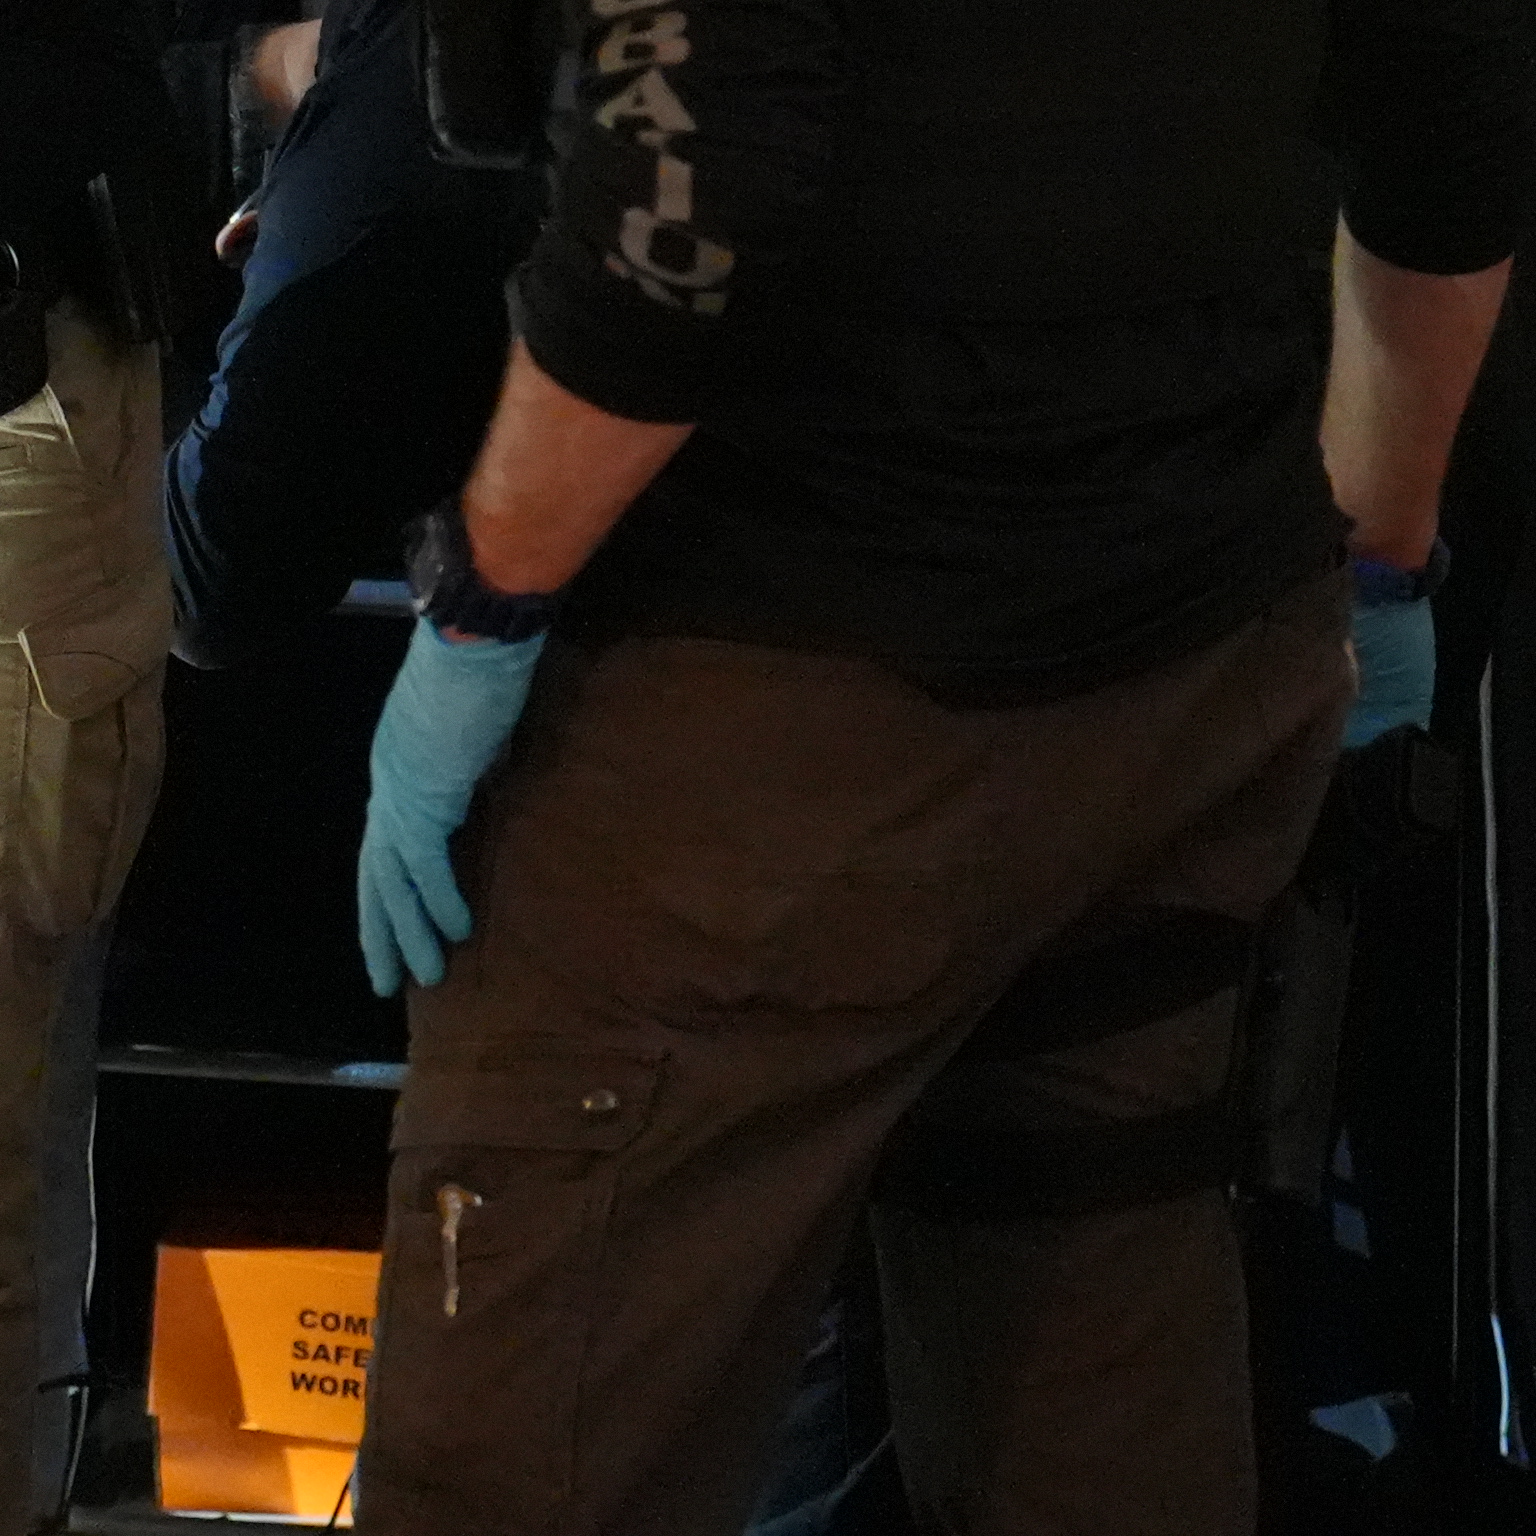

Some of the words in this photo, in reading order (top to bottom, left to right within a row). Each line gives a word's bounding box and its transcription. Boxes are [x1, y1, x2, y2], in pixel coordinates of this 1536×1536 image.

[298, 1309, 368, 1336] COM
[291, 1339, 371, 1368] SAFE
[290, 1370, 361, 1401] WOR
